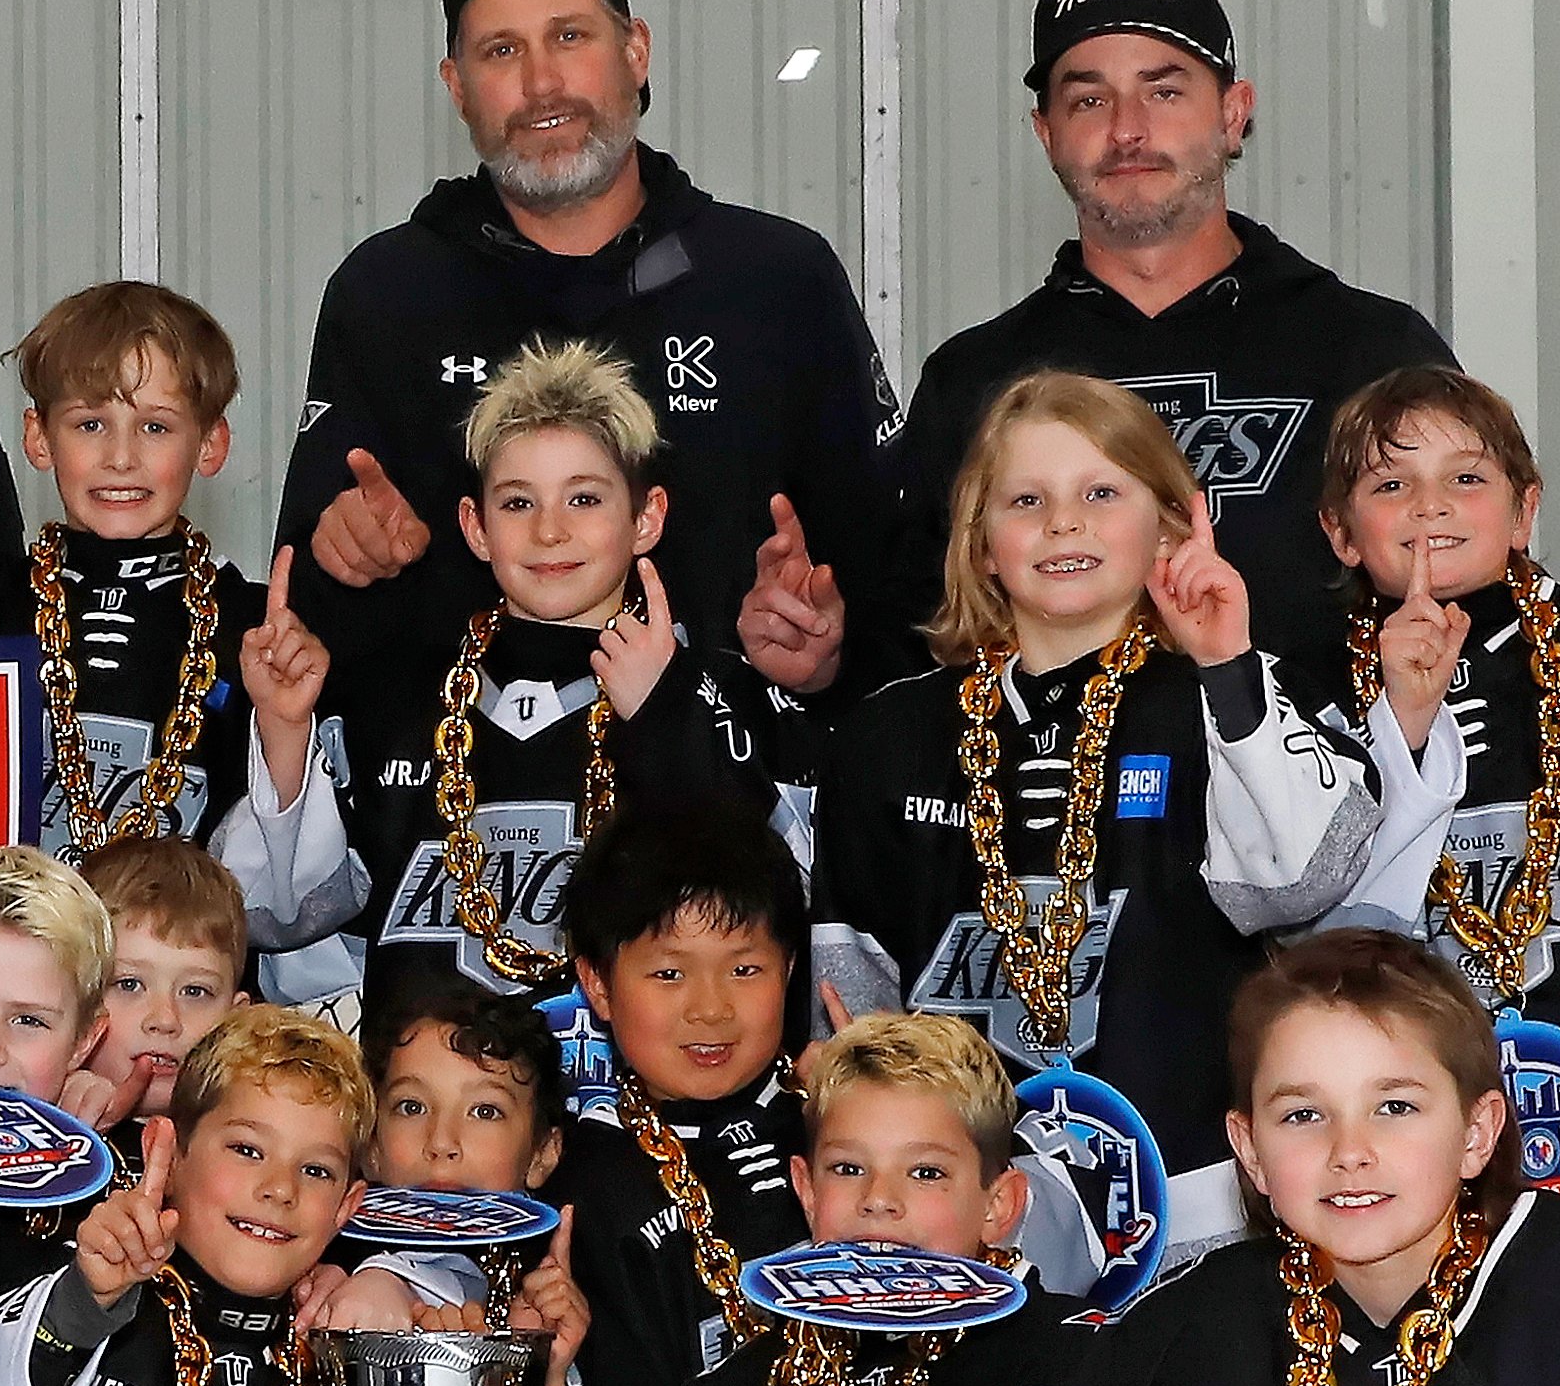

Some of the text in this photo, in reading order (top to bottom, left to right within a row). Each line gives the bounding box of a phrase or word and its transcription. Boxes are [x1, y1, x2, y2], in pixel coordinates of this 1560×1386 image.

[668, 394, 718, 411] Klevr
[875, 410, 905, 446] KLE
[87, 739, 121, 759] ung
[1118, 770, 1160, 795] ENCH
[489, 826, 540, 844] Young
[1446, 832, 1505, 851] Young
